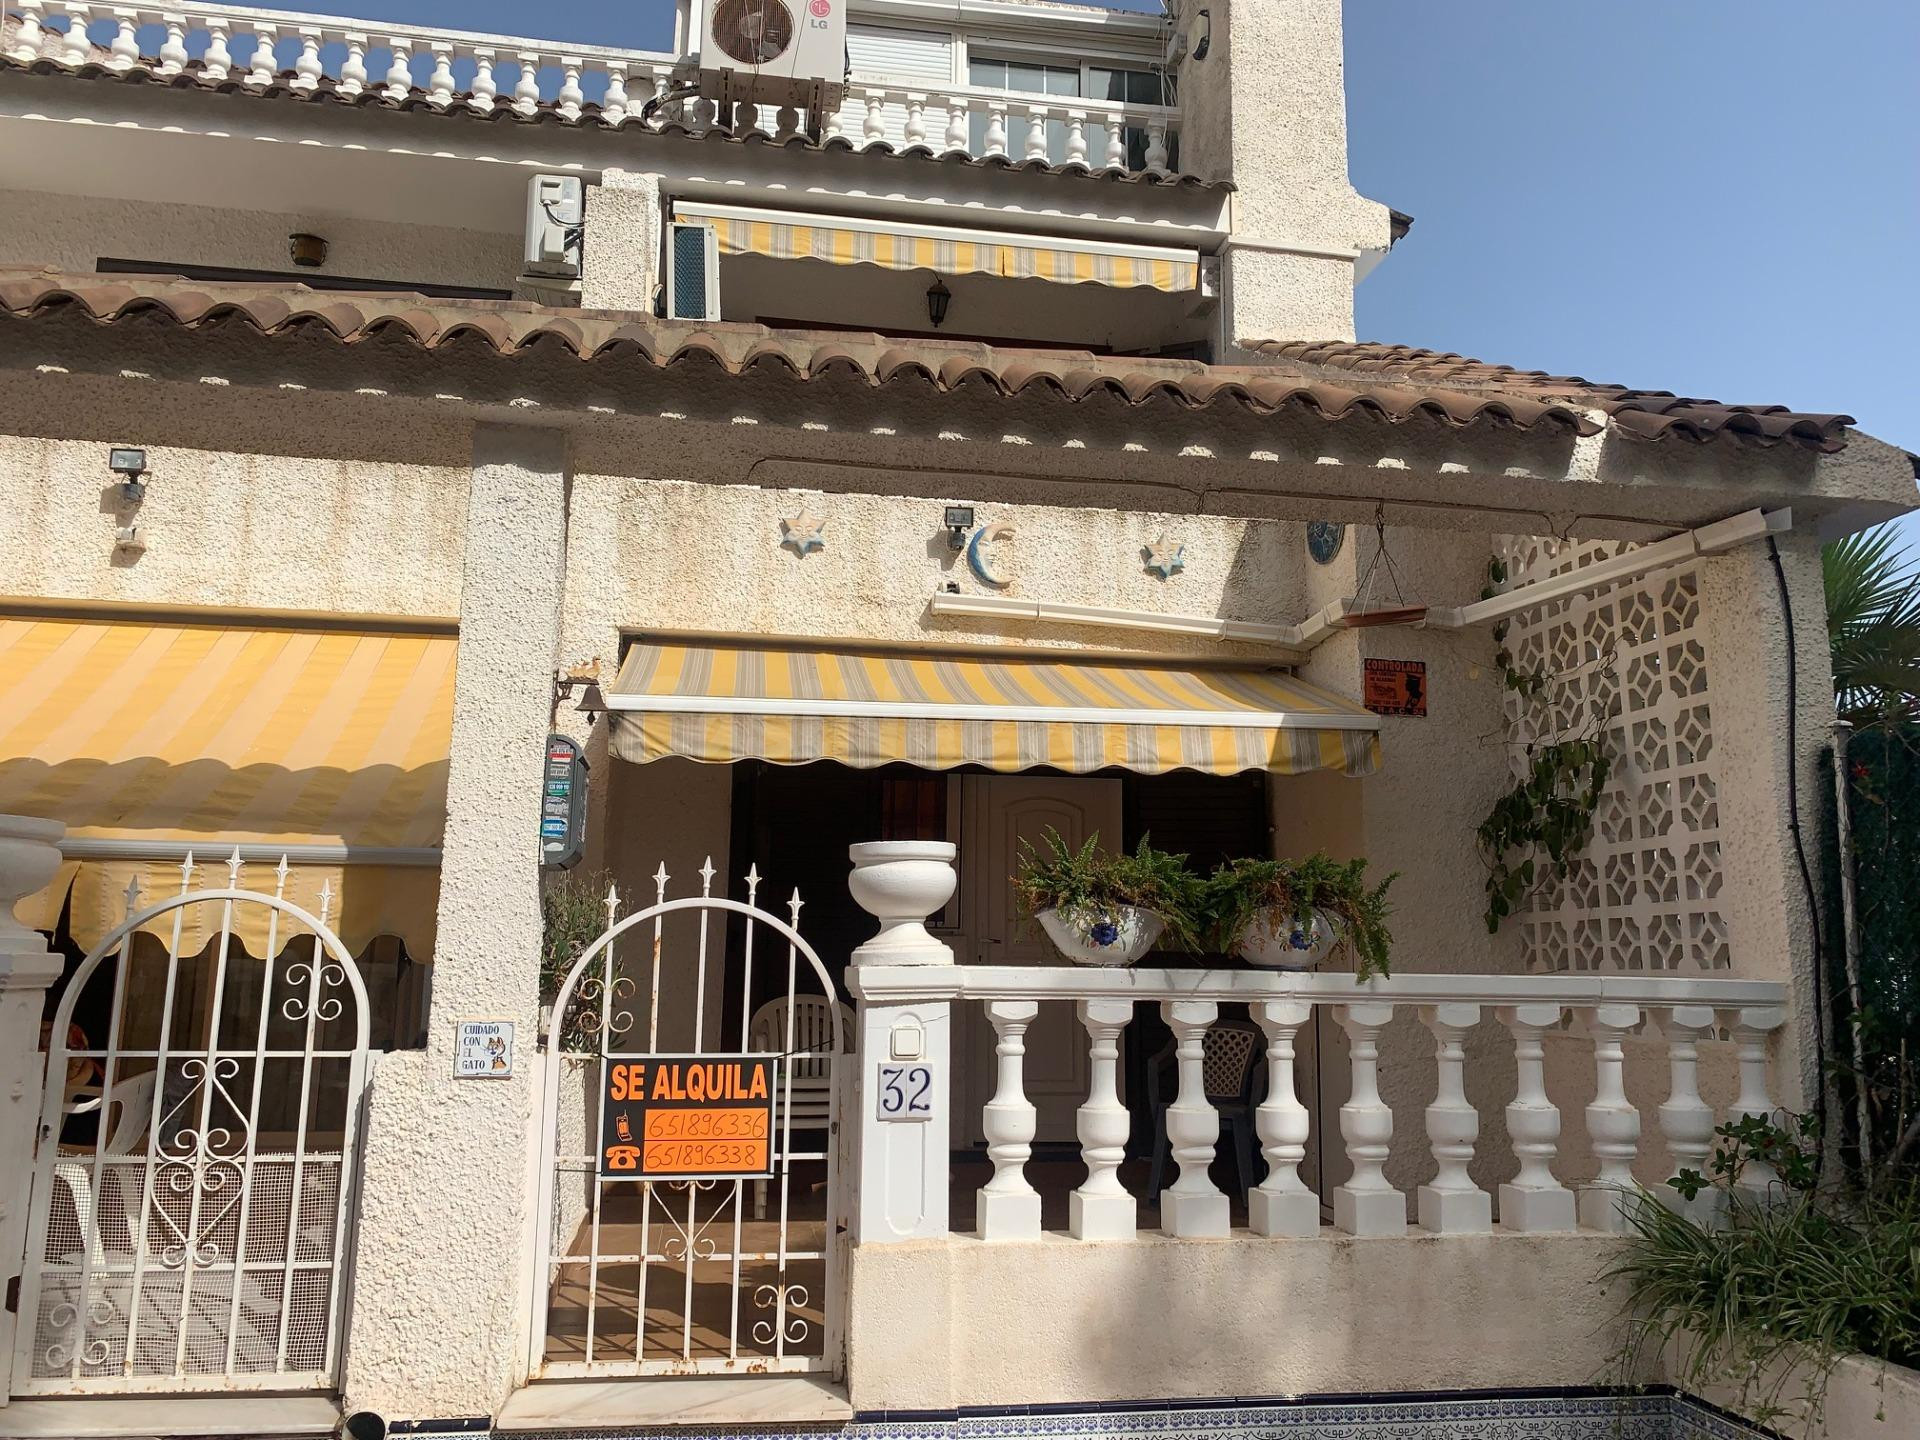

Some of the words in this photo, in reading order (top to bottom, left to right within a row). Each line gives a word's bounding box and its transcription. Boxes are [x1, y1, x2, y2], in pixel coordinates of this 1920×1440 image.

[810, 19, 828, 30] LG
[1366, 660, 1424, 673] CONTROLADA
[464, 1025, 500, 1035] CUIDADO
[463, 1036, 481, 1046] CON
[463, 1047, 473, 1057] EL
[461, 1059, 486, 1070] GATO
[610, 1064, 646, 1101] SE
[652, 1063, 768, 1103] ALQUILA
[882, 1067, 931, 1112] 32
[649, 1111, 767, 1138] 651896336
[644, 1143, 757, 1169] 651896338
